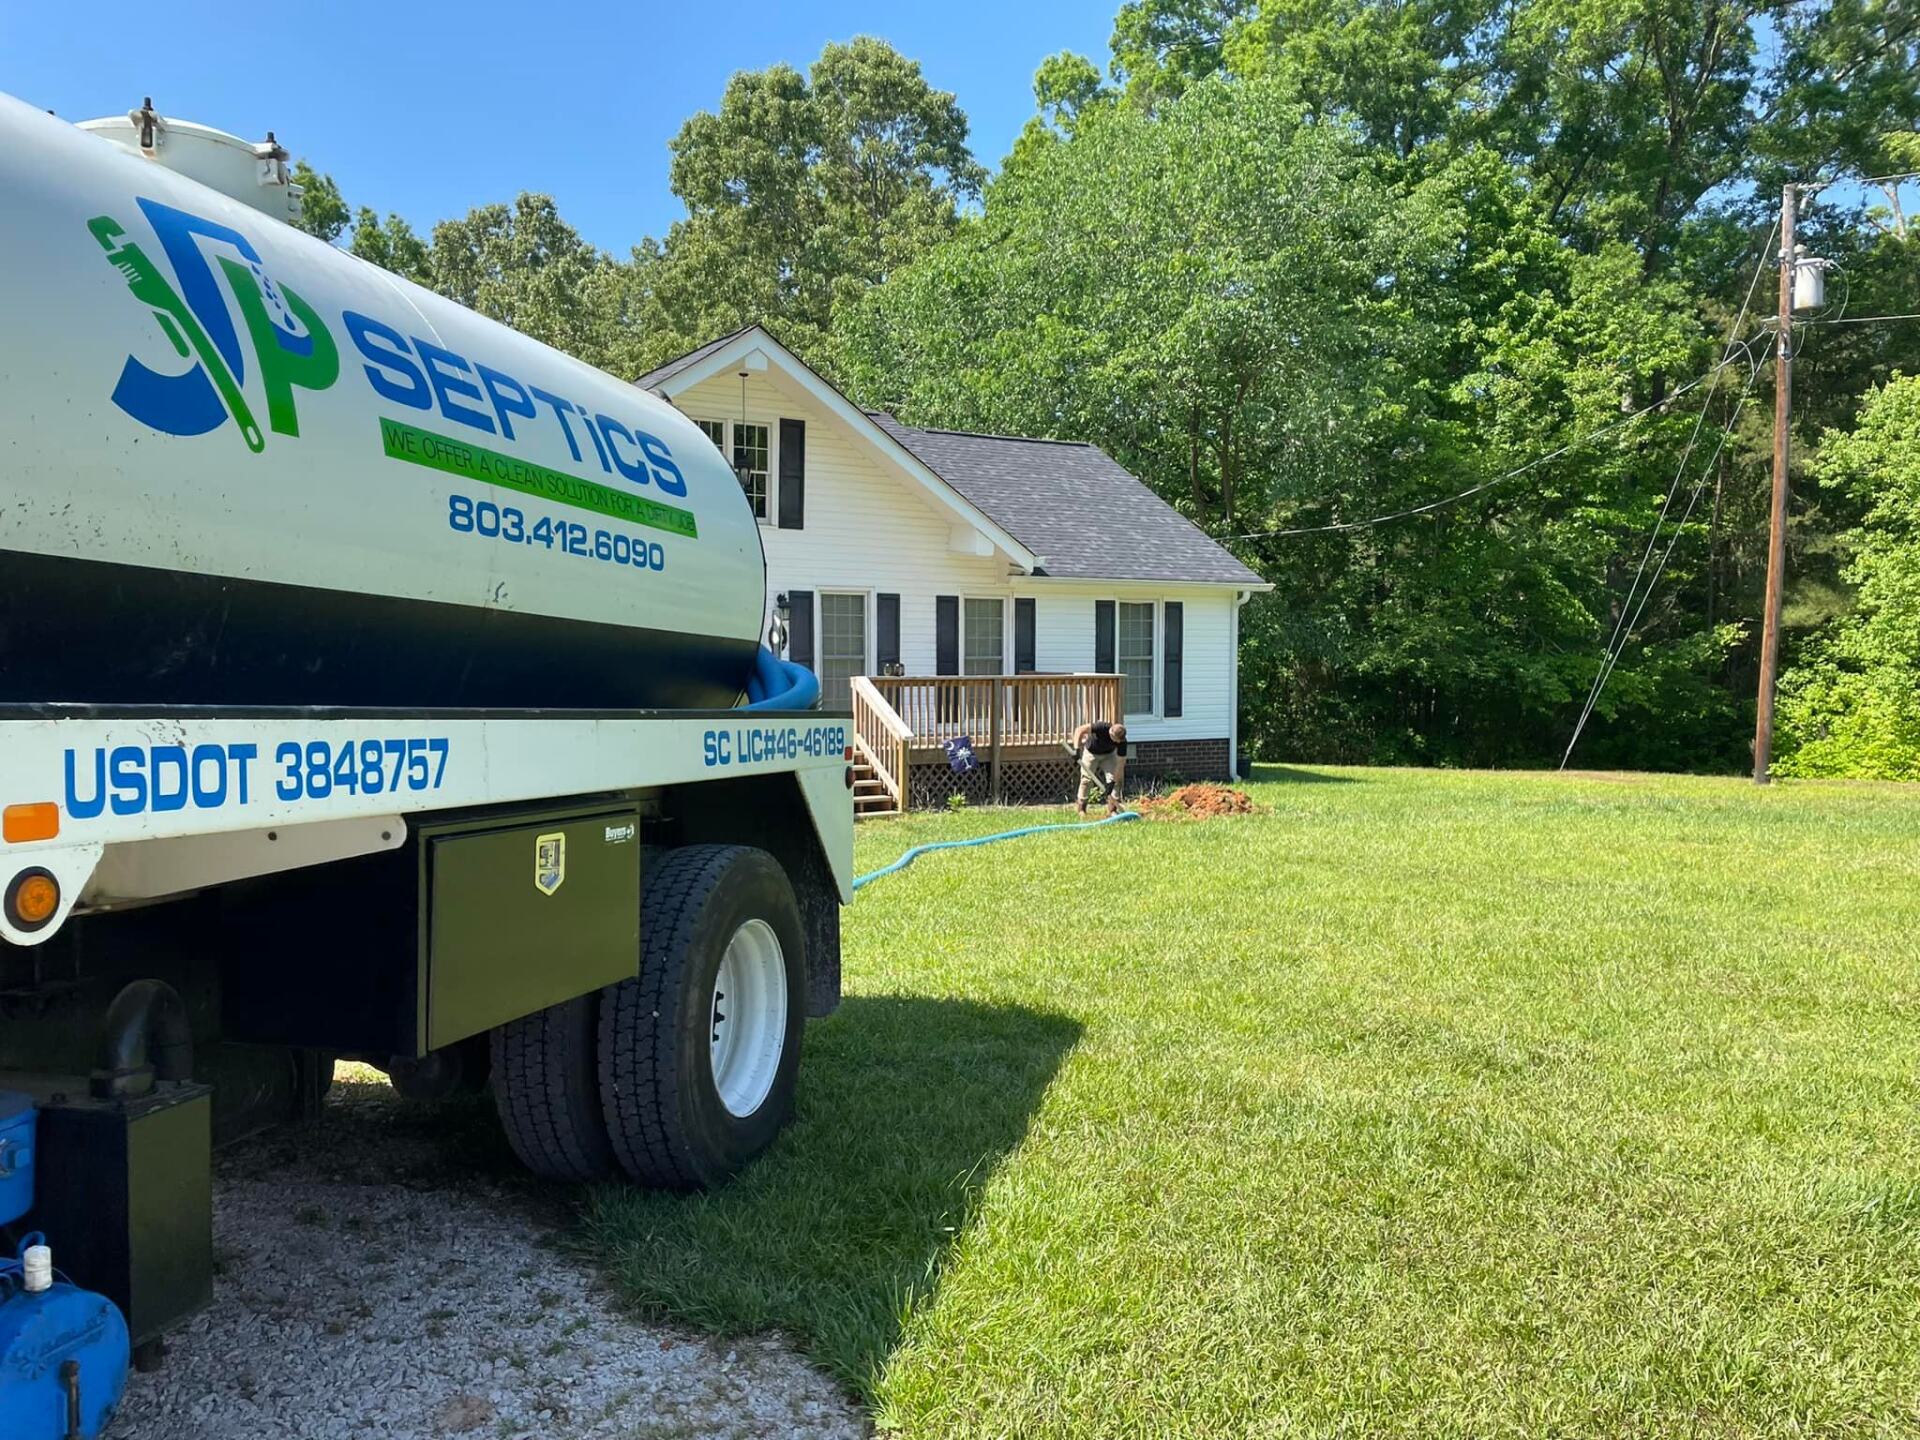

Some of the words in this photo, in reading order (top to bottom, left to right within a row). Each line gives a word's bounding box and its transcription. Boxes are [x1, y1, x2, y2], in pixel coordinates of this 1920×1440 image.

[386, 426, 416, 454] WE
[422, 437, 474, 471] OFFER
[479, 455, 492, 475] A
[494, 458, 544, 490] CLEAN
[546, 474, 609, 509] SOLUTION
[611, 493, 633, 514] FOR
[635, 500, 646, 518] A
[678, 510, 695, 532] JOB
[448, 494, 665, 571] 803.412.6090
[64, 743, 258, 819] USDOT
[275, 738, 449, 801] 3848757
[703, 730, 731, 766] SC
[737, 727, 844, 763] LIC#46-46189
